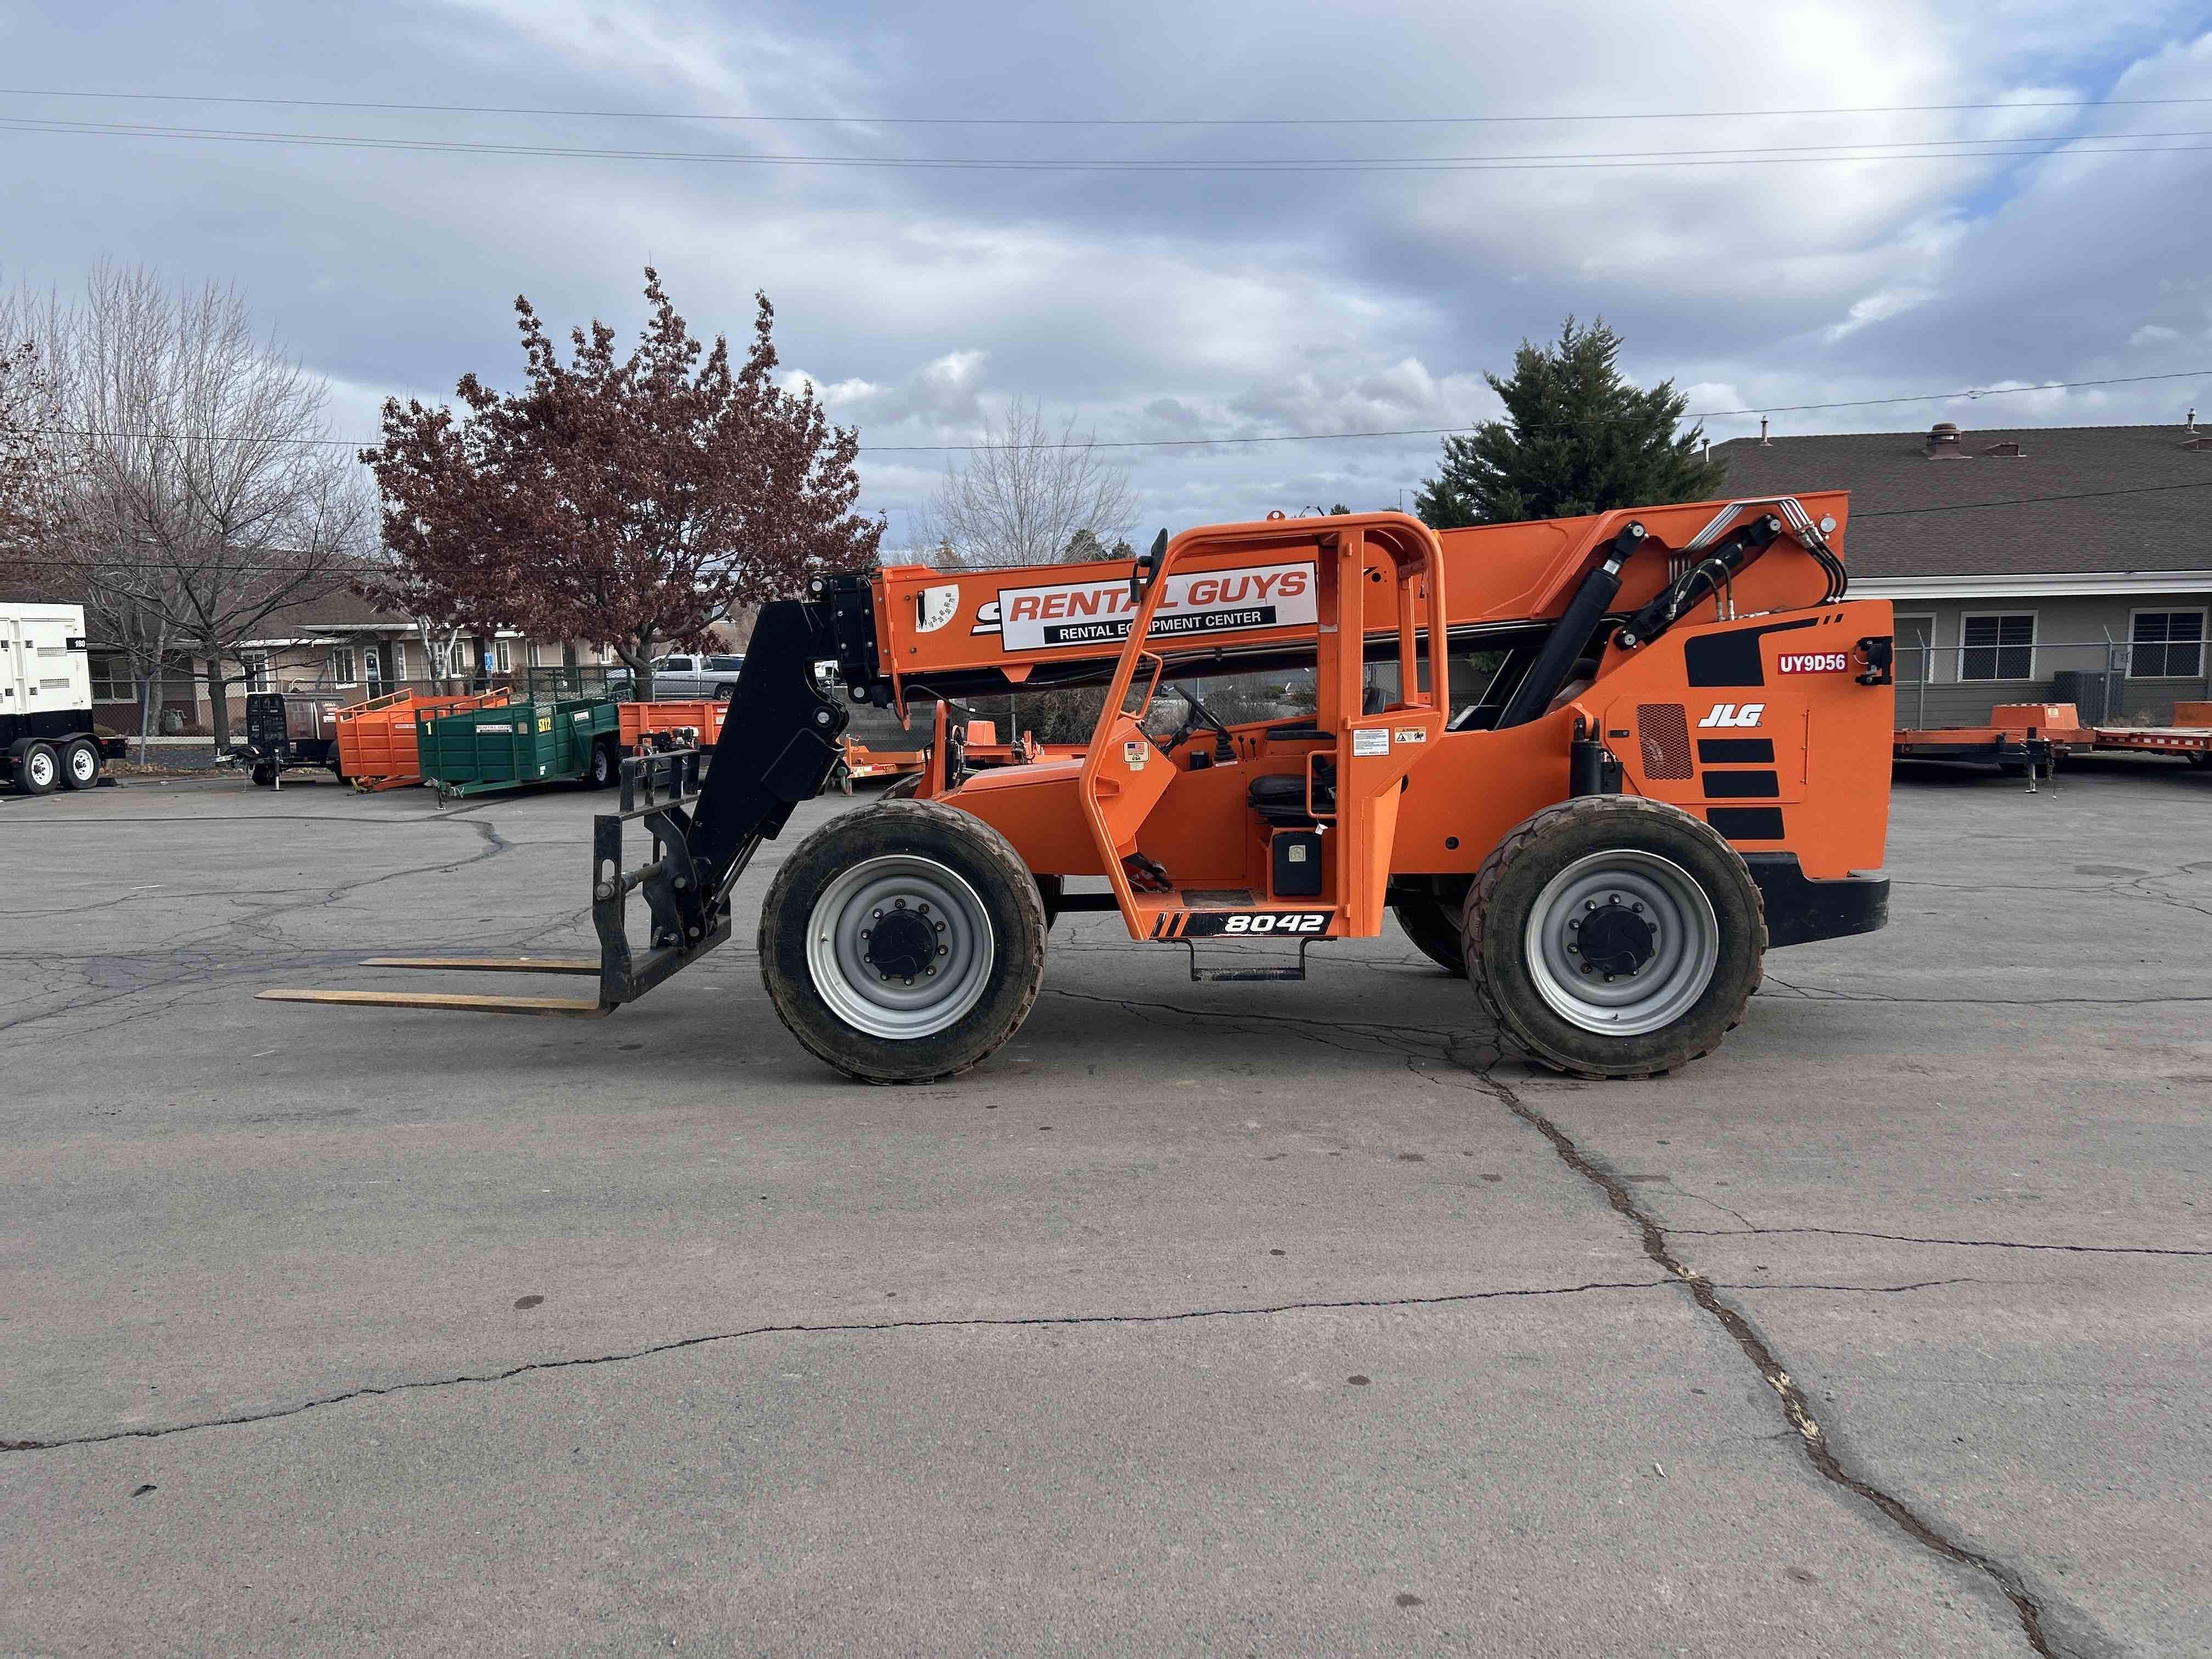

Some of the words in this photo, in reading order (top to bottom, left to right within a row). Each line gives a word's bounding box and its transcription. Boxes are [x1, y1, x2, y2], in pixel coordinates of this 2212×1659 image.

[1188, 571, 1307, 606] GUYS
[1059, 625, 1114, 640] RENTAL
[1118, 616, 1201, 635] EIPMENT
[1205, 611, 1261, 627] CENTER
[1780, 654, 1846, 673] UY9D56
[1697, 703, 1766, 728] JLG
[425, 721, 432, 735] 1
[1224, 915, 1325, 932] 8042
